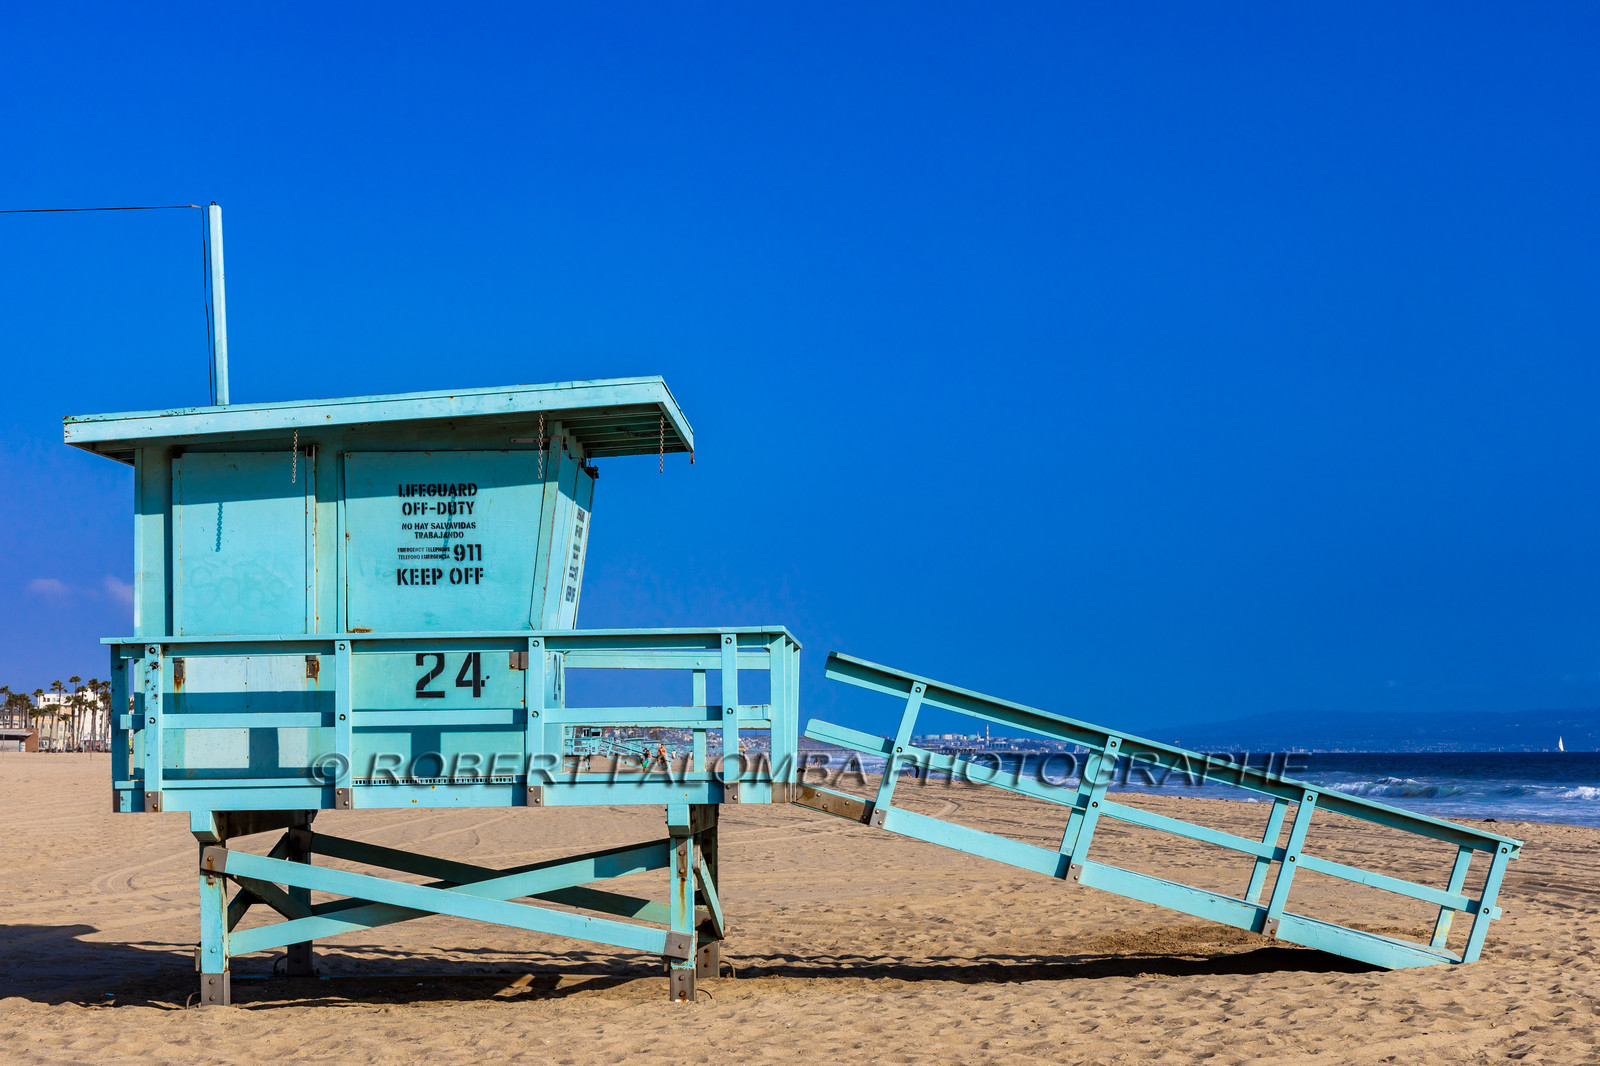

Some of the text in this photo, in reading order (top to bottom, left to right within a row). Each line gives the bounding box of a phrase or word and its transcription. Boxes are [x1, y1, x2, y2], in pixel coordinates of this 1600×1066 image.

[398, 483, 478, 497] LIFEGUARD
[402, 501, 475, 516] OFF-DUTY
[414, 522, 429, 530] HAY
[430, 521, 476, 530] SALVAVIDAS
[414, 531, 464, 539] TRABAJANDO
[453, 543, 482, 562] 911
[397, 567, 484, 586] KEEP OFF
[415, 652, 485, 698] 24
